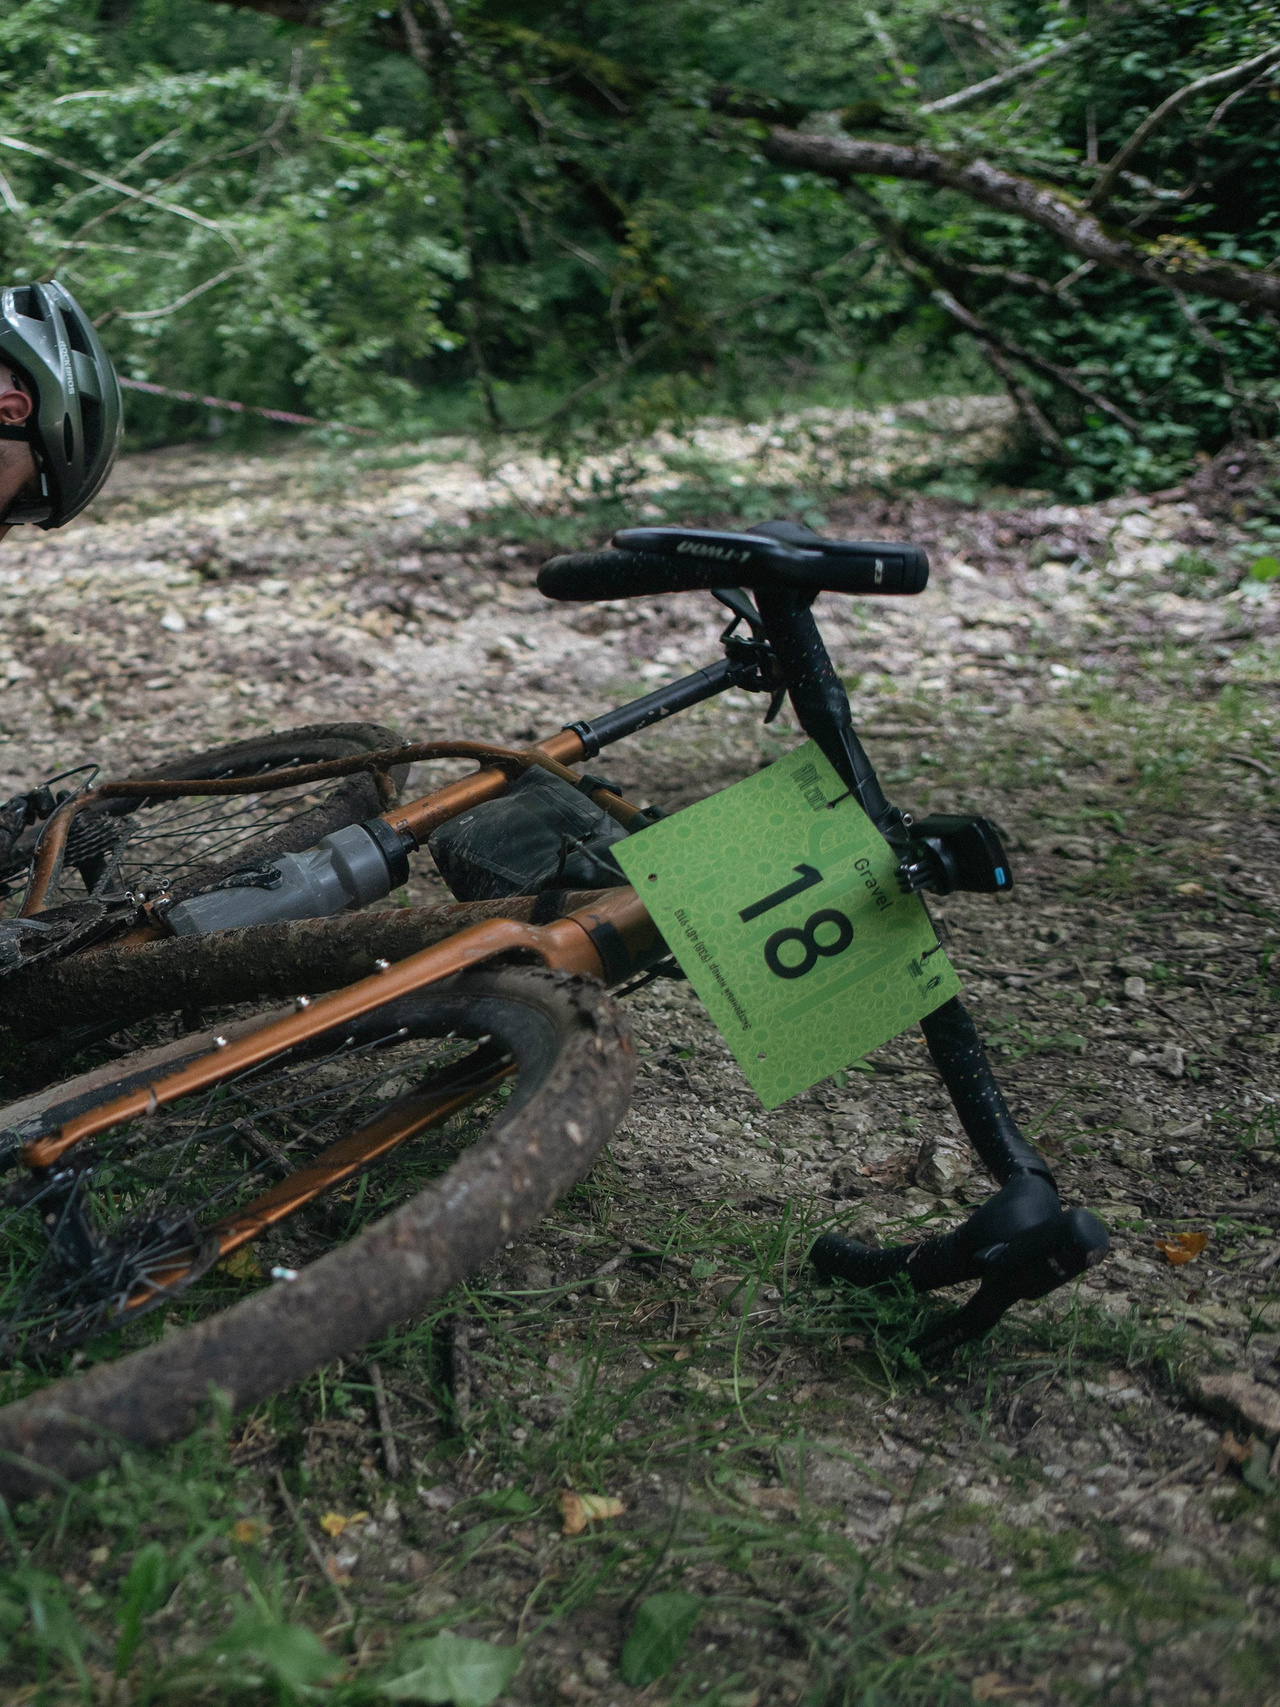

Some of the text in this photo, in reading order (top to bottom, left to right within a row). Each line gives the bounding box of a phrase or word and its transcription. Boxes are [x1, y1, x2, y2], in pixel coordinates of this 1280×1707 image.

[854, 858, 893, 912] Gravel
[673, 908, 699, 942] 481-9113
[738, 863, 854, 979] 18
[693, 941, 712, 964] (938)
[720, 988, 752, 1031] Экстренный
